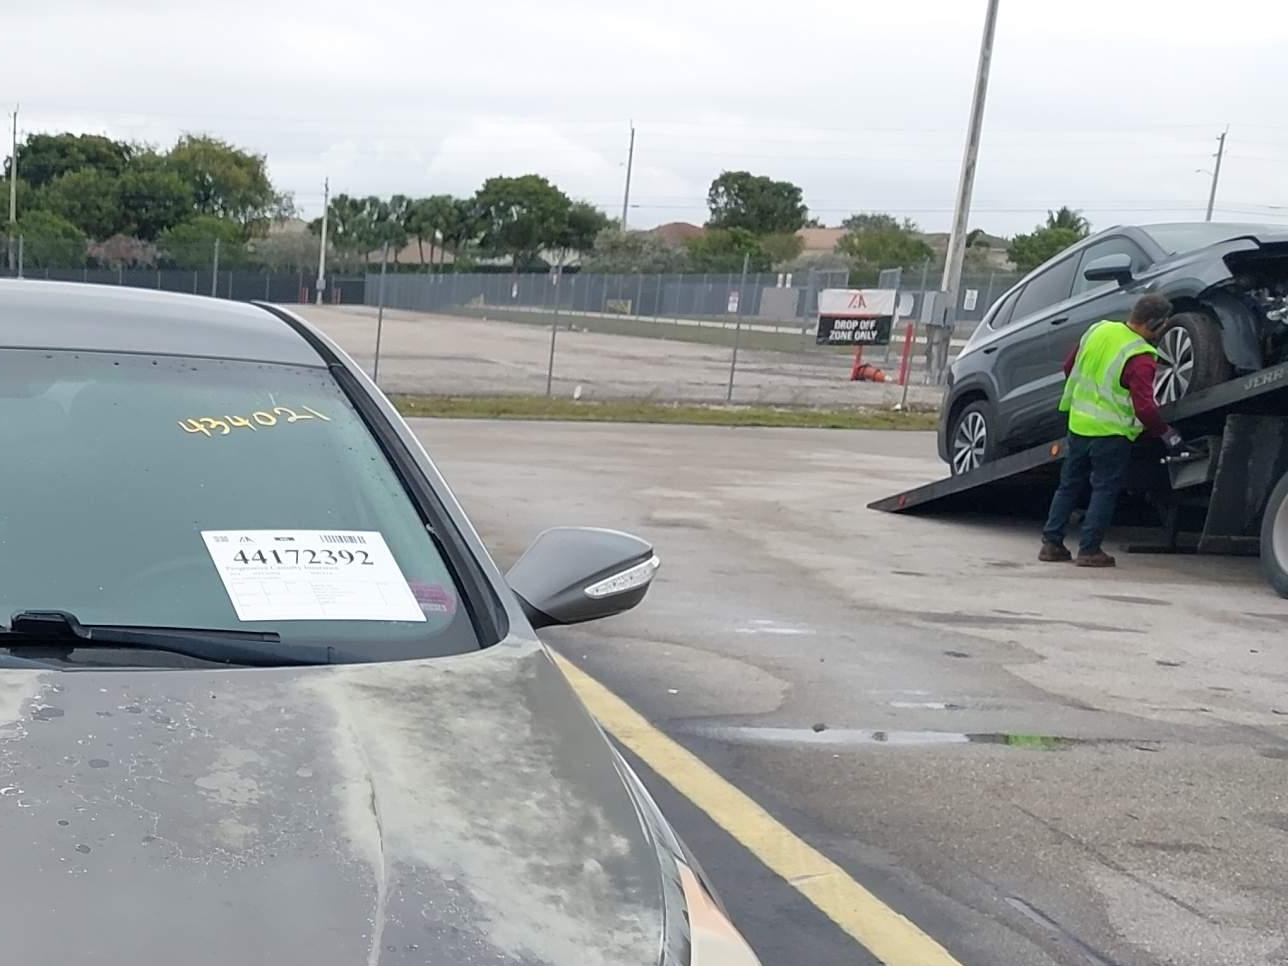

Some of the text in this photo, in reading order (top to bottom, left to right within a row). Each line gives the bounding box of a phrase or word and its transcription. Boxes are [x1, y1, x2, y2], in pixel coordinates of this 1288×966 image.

[834, 320, 876, 330] DROP OFF
[829, 330, 878, 340] ZONE ONLY
[177, 405, 331, 437] 434021
[233, 549, 374, 566] 44172392
